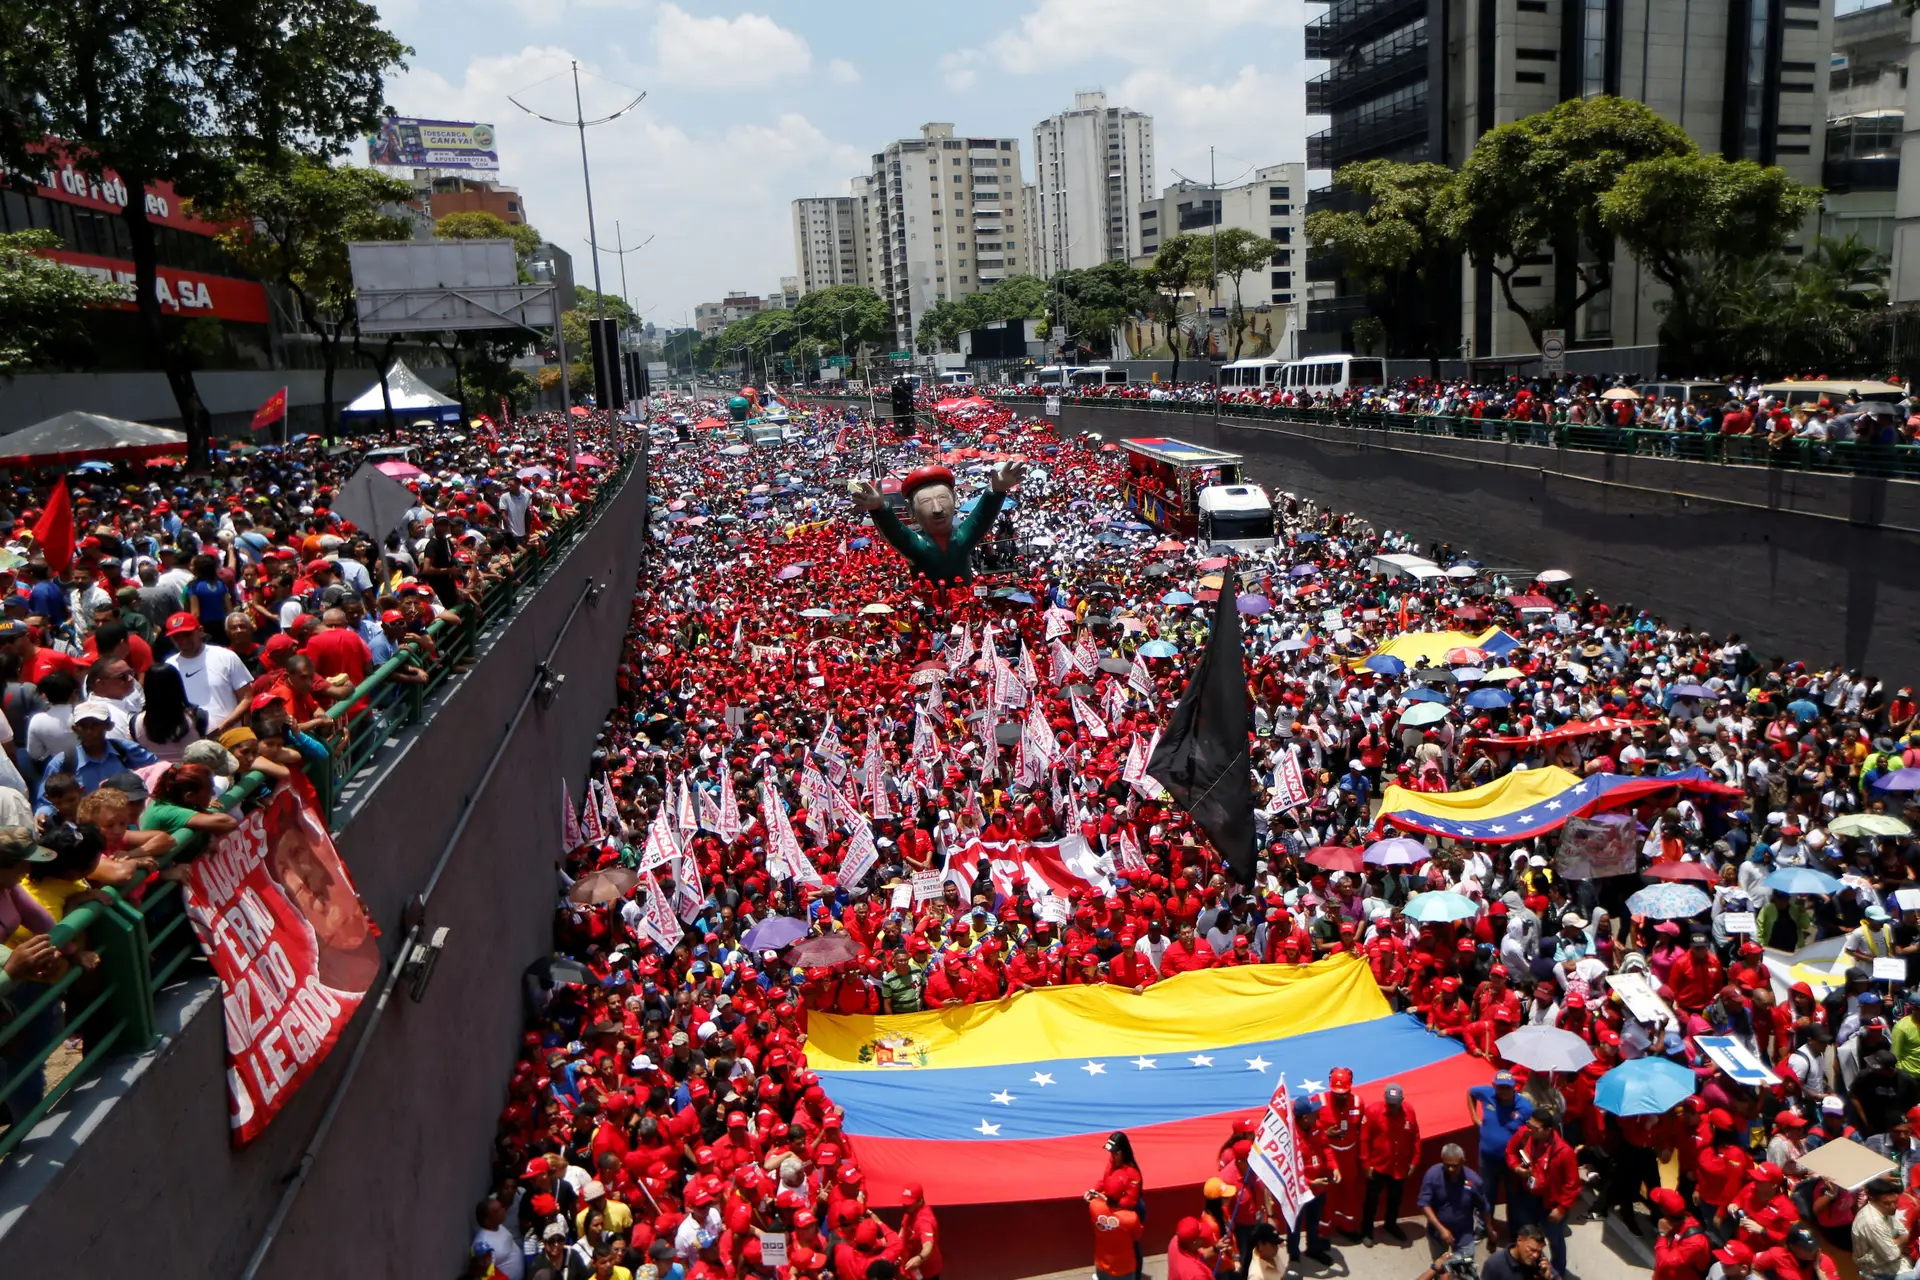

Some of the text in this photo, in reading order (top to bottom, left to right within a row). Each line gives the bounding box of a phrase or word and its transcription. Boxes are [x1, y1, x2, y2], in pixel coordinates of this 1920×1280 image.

[431, 137, 456, 145] GANA
[61, 164, 87, 198] de
[1283, 796, 1292, 806] ES
[251, 974, 341, 1104] LEGADO
